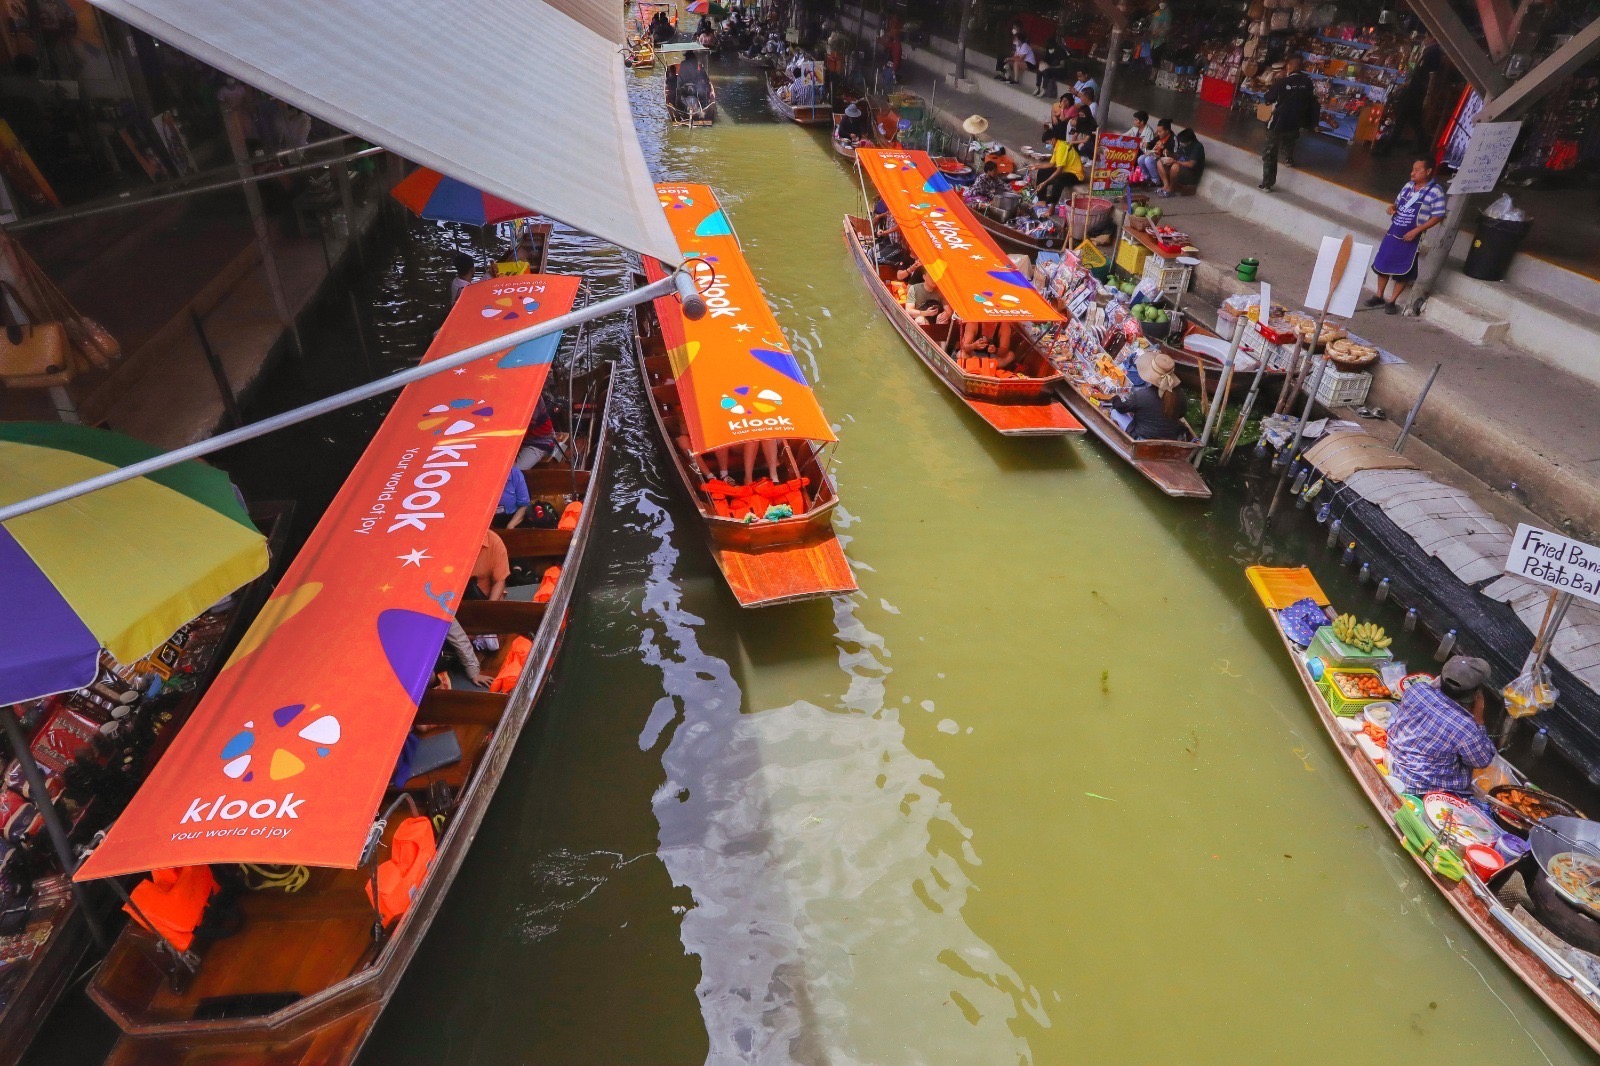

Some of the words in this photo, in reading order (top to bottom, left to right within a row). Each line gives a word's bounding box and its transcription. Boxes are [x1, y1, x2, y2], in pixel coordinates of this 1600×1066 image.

[932, 220, 973, 250] klook
[492, 285, 546, 296] klook
[696, 274, 742, 319] klook
[728, 415, 793, 430] klook
[377, 471, 404, 501] world
[387, 443, 478, 534] klook
[369, 503, 386, 515] of
[353, 516, 383, 535] joy
[1522, 530, 1566, 561] Fried
[1522, 556, 1569, 585] Potato
[179, 792, 306, 825] klook
[205, 827, 248, 838] world
[250, 826, 268, 836] of
[265, 826, 292, 839] joy
